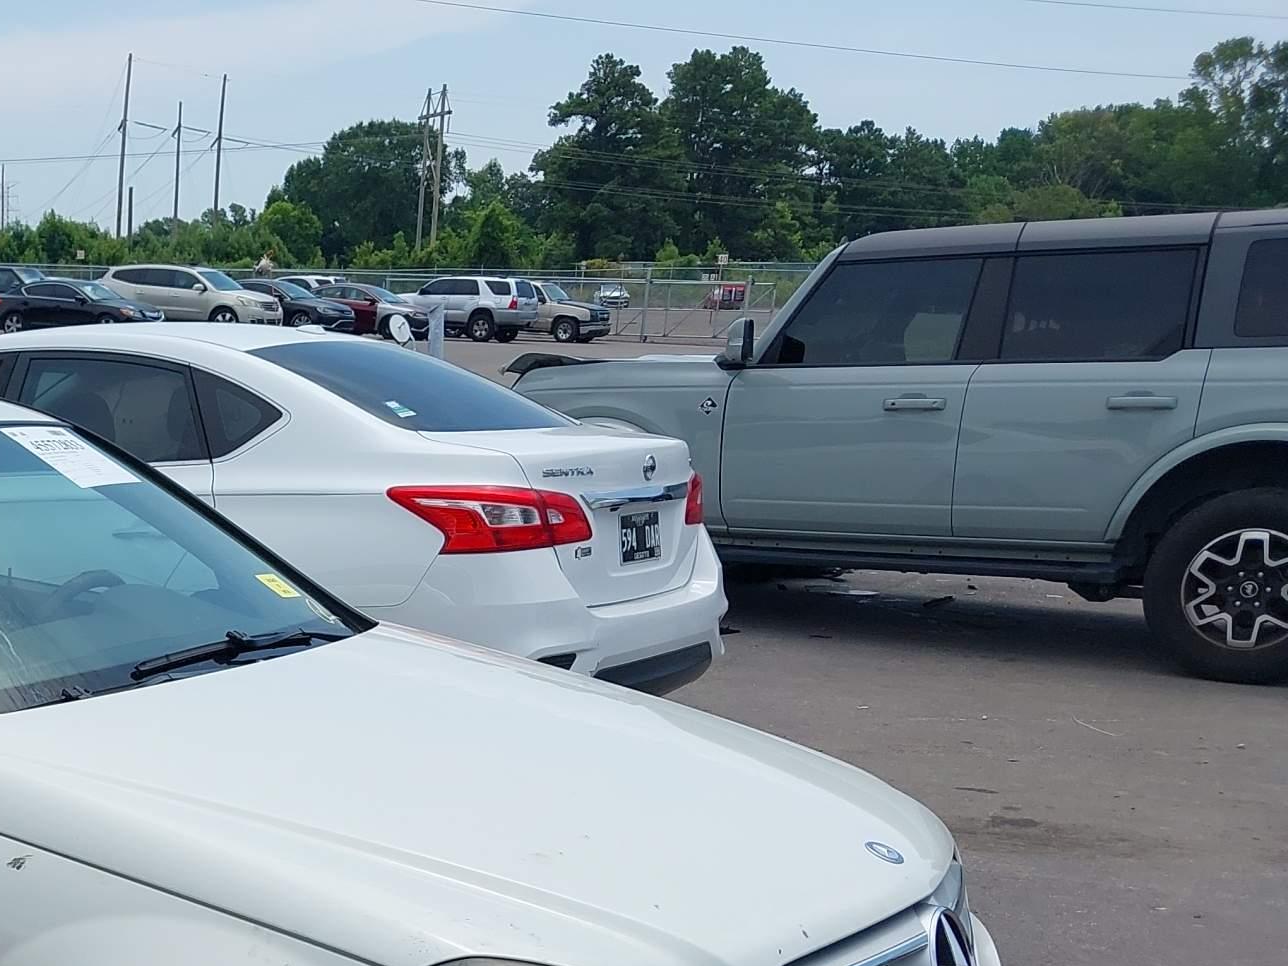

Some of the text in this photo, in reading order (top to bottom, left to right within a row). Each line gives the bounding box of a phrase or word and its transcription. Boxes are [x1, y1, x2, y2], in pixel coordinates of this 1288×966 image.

[542, 467, 594, 477] SENTRA
[622, 527, 637, 552] 594
[645, 524, 661, 549] DAR
